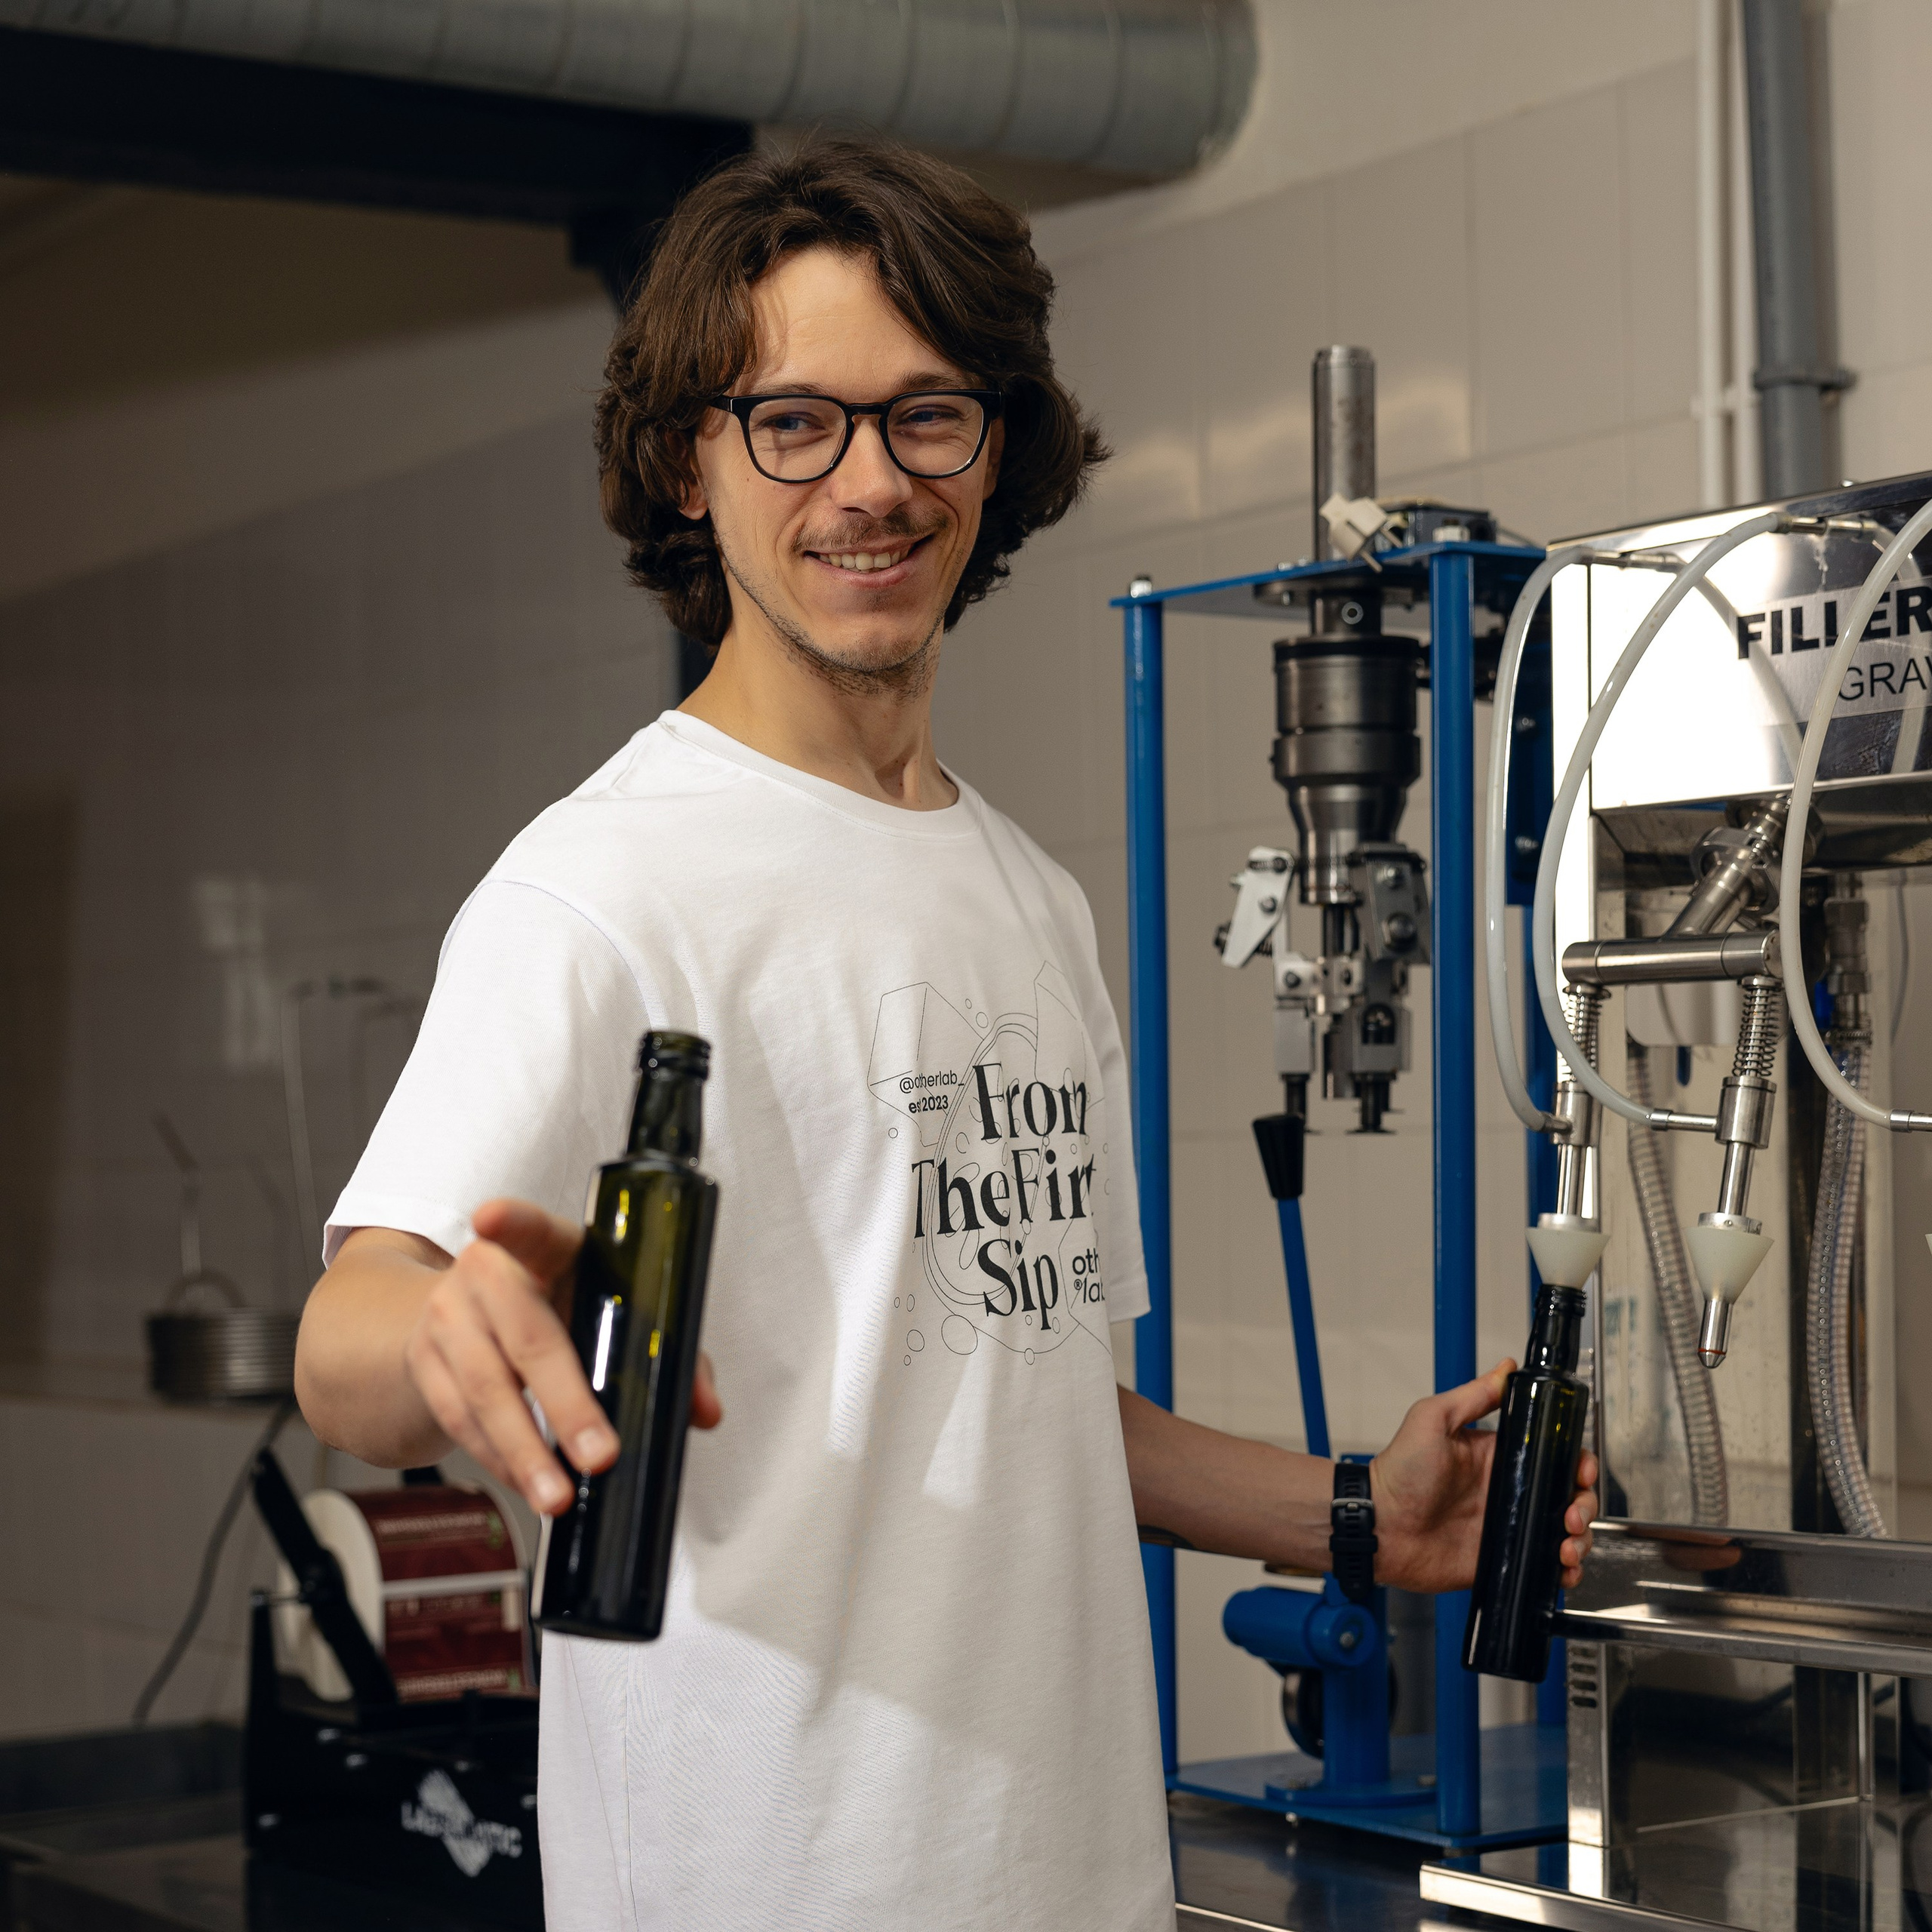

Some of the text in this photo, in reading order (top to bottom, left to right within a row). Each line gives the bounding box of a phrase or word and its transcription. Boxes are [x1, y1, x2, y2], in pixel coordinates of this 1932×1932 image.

[1738, 586, 1932, 659] FILLER
[921, 1095, 949, 1112] 2023
[912, 1157, 1011, 1238] The
[977, 1238, 1058, 1331] Sip
